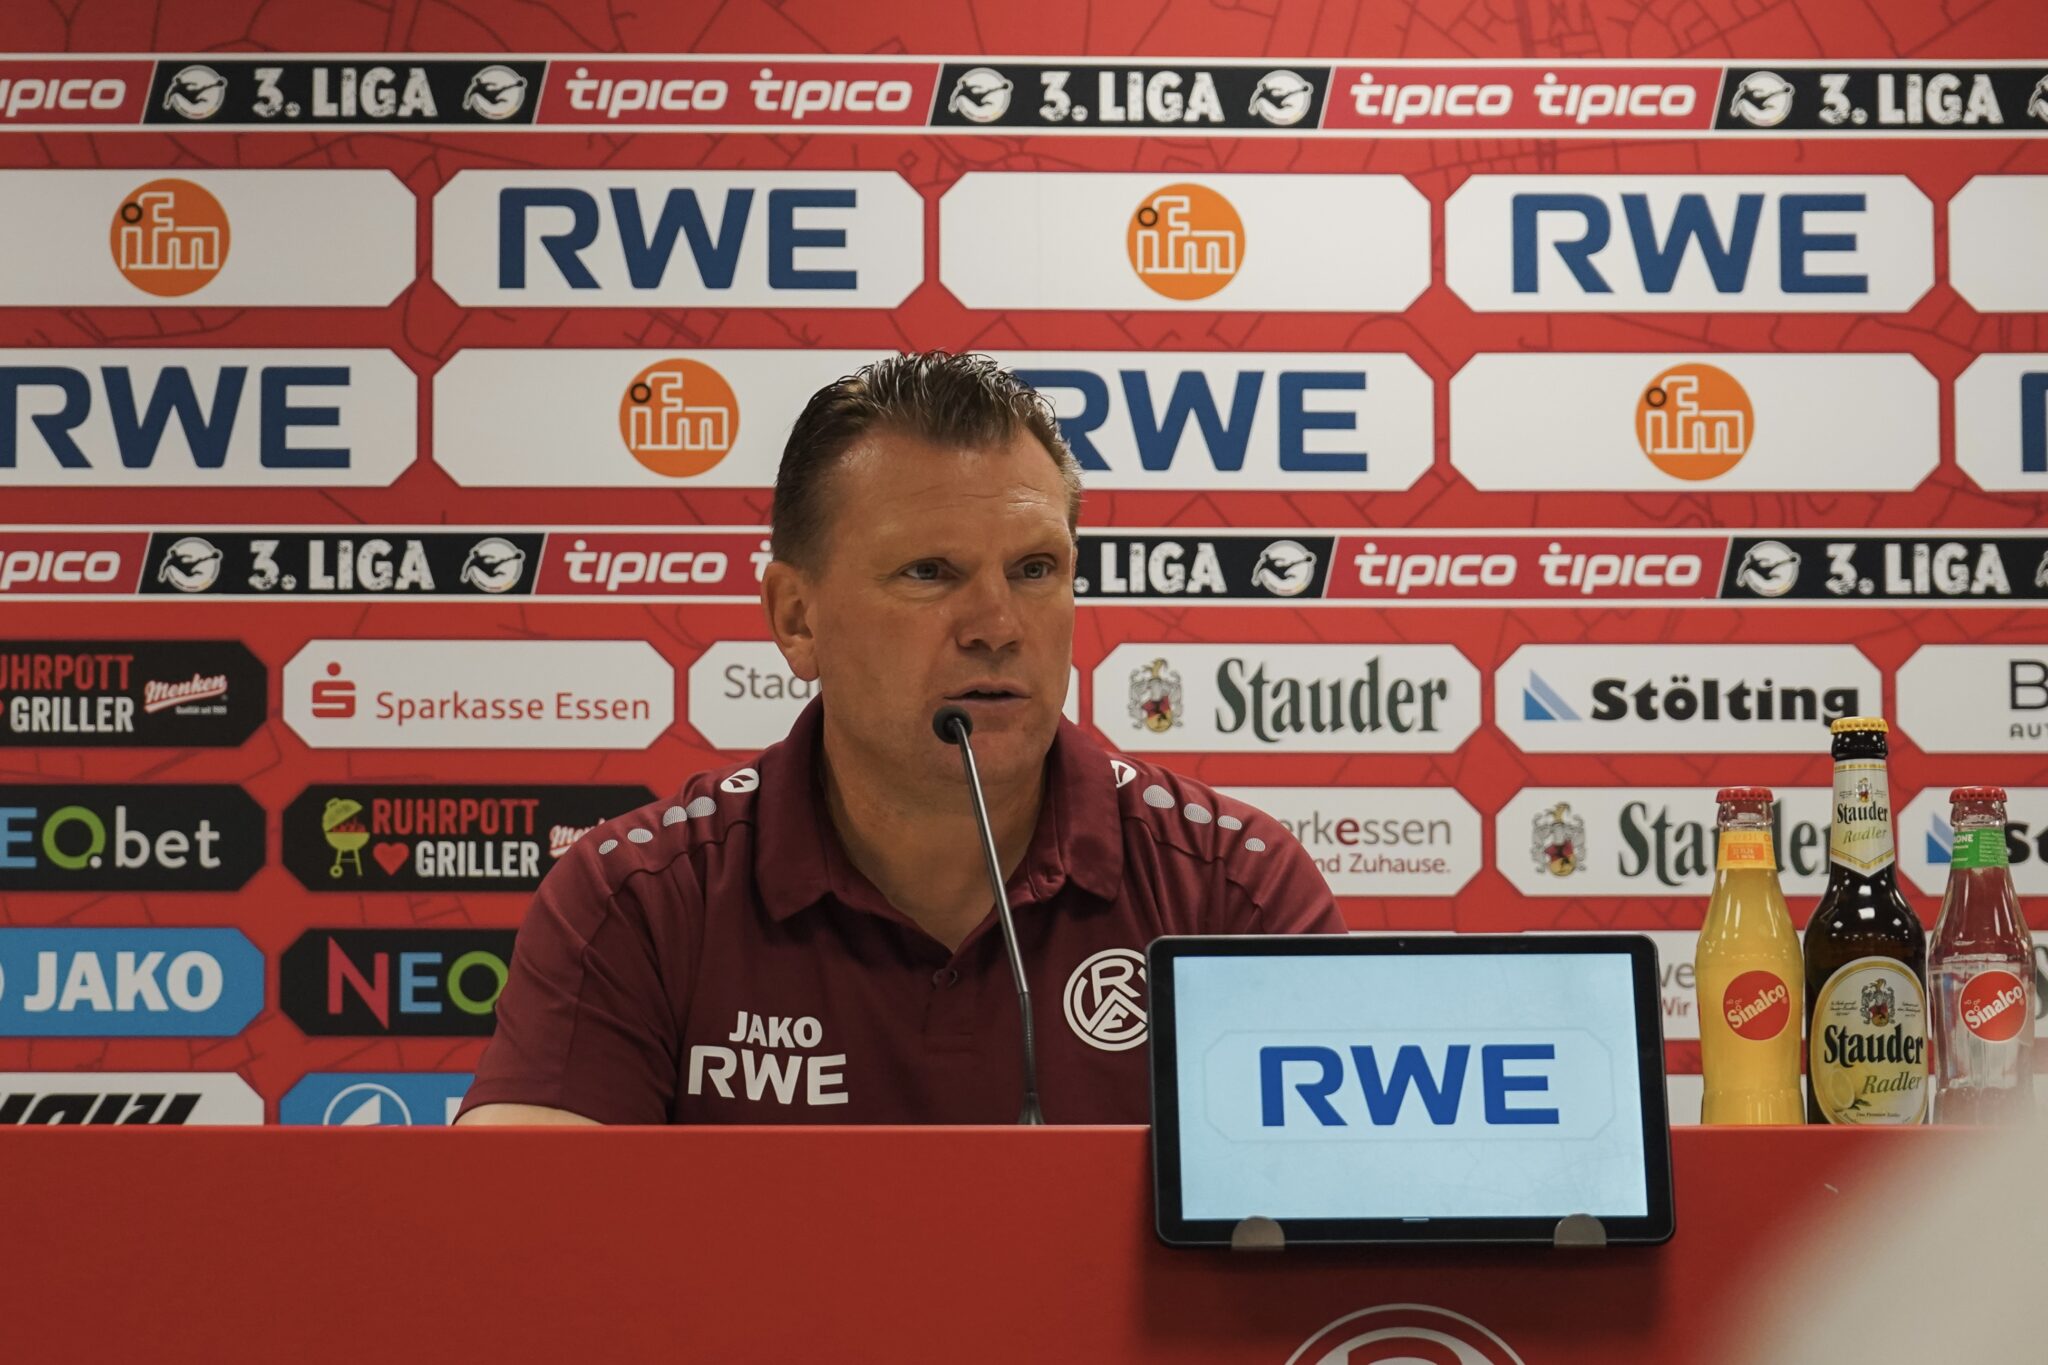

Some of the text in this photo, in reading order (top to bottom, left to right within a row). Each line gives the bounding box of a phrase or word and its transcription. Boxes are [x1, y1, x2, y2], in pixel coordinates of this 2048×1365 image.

[252, 67, 438, 117] 3. LIGA
[566, 69, 912, 119] tipico tipico
[1040, 70, 1225, 122] 3. LIGA
[1351, 73, 1697, 124] tipico tipico
[1819, 74, 2003, 125] 3. LIGA
[120, 191, 221, 270] ifm
[499, 187, 858, 290] RWE
[1136, 195, 1237, 275] ifm
[1512, 193, 1868, 294] RWE
[0, 366, 352, 468] RWE
[629, 371, 729, 450] ifm
[1010, 369, 1368, 472] RWE
[1645, 376, 1745, 455] ifm
[248, 539, 437, 590] 3. LIGA
[564, 539, 728, 591] tipico
[1101, 541, 1227, 594] LIGA
[1354, 542, 1701, 594] tipico tipico
[1826, 543, 2011, 595] 3. LIGA
[144, 672, 227, 705] Menken
[723, 664, 821, 699] Stad
[1215, 655, 1447, 743] Stauder
[1591, 675, 1859, 727] Stölting
[10, 695, 134, 733] GRILLER
[375, 691, 650, 726] Sparkasse Essen
[372, 798, 540, 836] RUHRPOTT
[1836, 801, 1888, 825] Stauder
[1843, 827, 1888, 845] Radler
[414, 840, 540, 877] GRILLER
[1348, 852, 1452, 874] Zuhause.
[24, 951, 223, 1012] JAKO
[328, 936, 509, 1030] NEO
[1726, 983, 1787, 1029] Sinalco
[729, 1010, 823, 1048] JAKO
[1964, 986, 2023, 1029] Sinalco
[1824, 1023, 1924, 1068] Stauder
[687, 1045, 849, 1106] RWE
[1259, 1044, 1560, 1127] RWE
[1862, 1071, 1922, 1095] Radler
